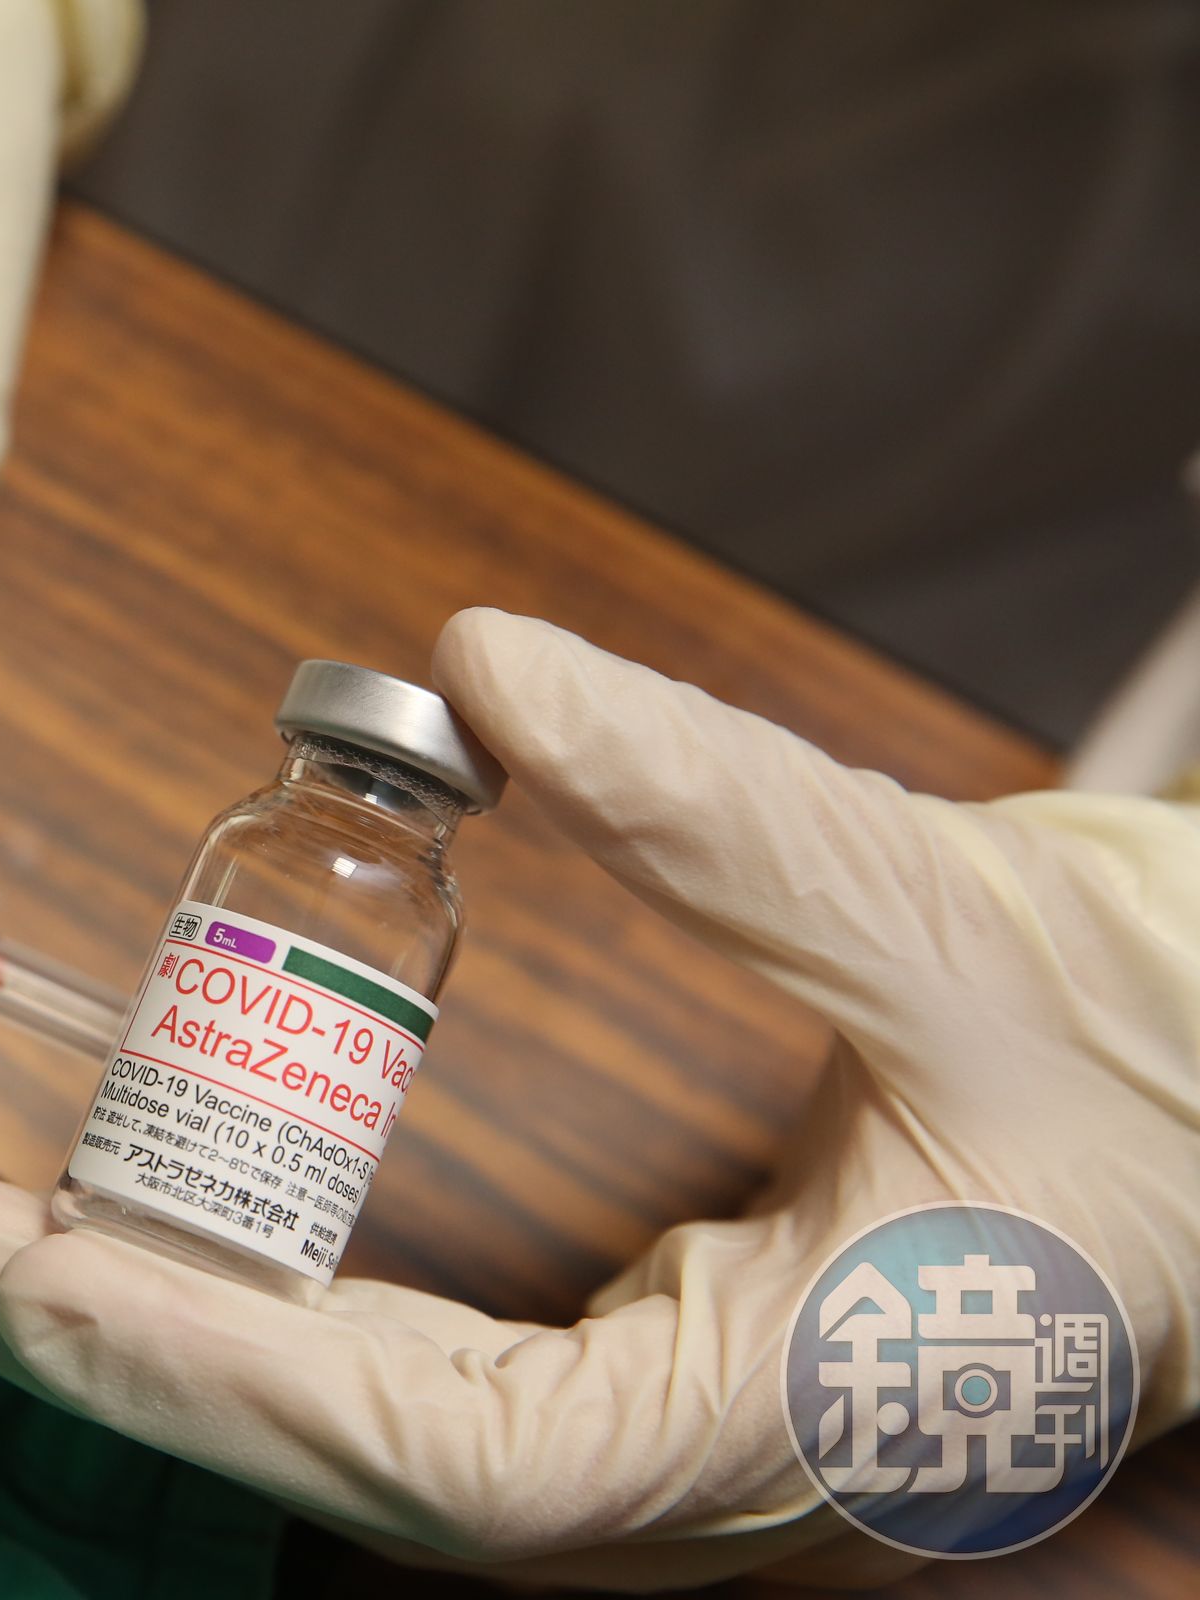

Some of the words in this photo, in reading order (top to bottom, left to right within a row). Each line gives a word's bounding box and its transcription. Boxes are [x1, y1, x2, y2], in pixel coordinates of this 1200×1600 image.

[171, 915, 198, 938] 生物
[213, 927, 237, 949] 5mL
[175, 958, 374, 1065] COVID-19
[151, 1004, 382, 1131] AstraZeneca
[100, 1079, 170, 1118] Multidose
[176, 1109, 211, 1134] vial
[214, 1121, 249, 1149] (10
[252, 1140, 267, 1158] x
[271, 1145, 303, 1172] 0.5
[304, 1163, 328, 1185] ml
[327, 1174, 364, 1210] doses)
[111, 1057, 188, 1098] COVID-19
[195, 1084, 272, 1132] Vaccine
[278, 1121, 369, 1181] (ChAdOx1-S
[123, 1143, 300, 1232] アストラゼネカ株式会社
[135, 1172, 275, 1240] 大阪市北区大深町3番1号
[300, 1238, 329, 1268] Meiji
